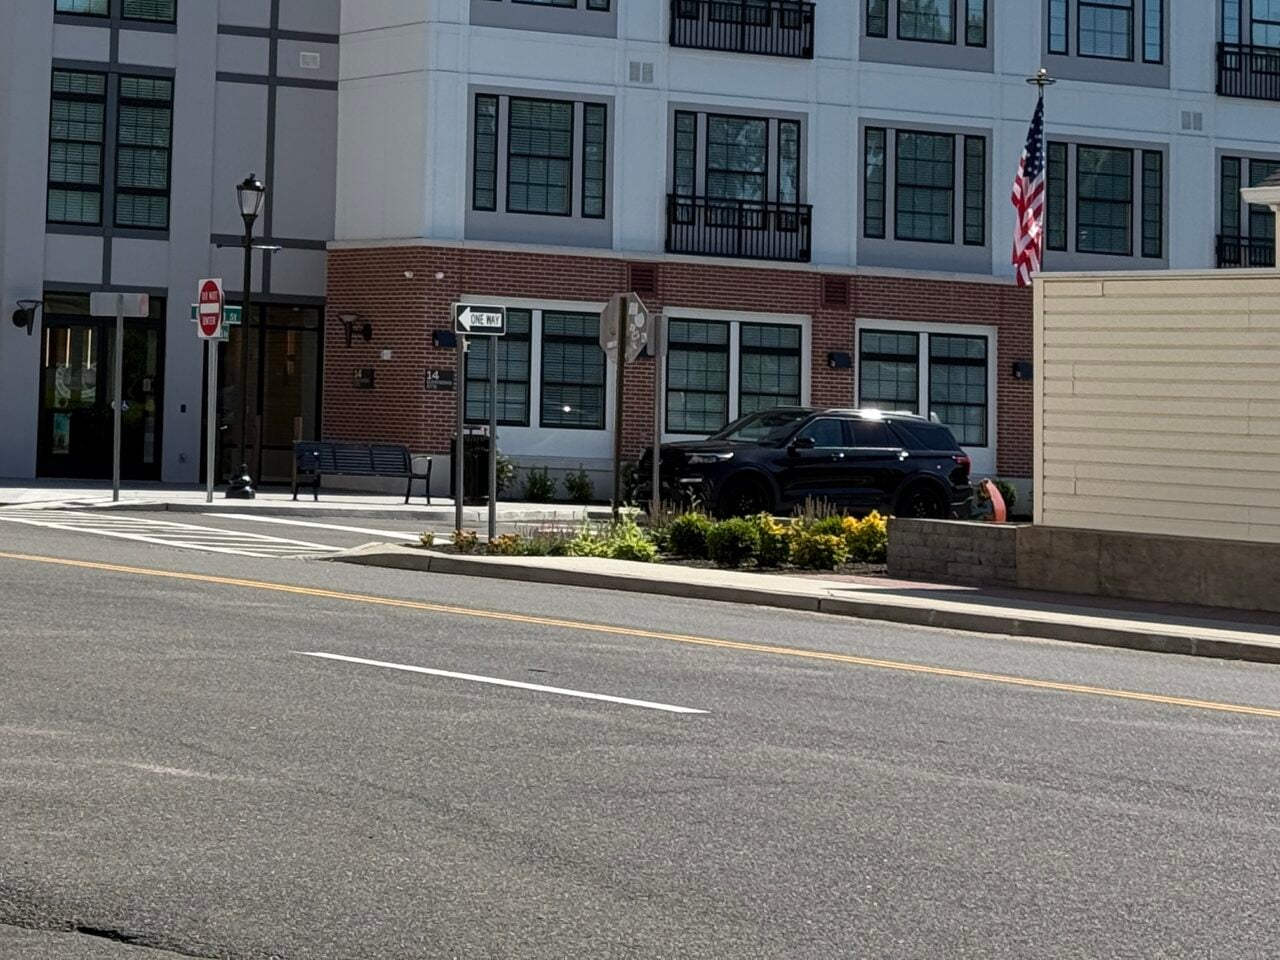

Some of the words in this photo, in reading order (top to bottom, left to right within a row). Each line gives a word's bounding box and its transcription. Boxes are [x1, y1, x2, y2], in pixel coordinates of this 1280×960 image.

[201, 290, 208, 300] DO
[209, 290, 218, 300] NOT
[202, 316, 216, 326] ENTER
[471, 313, 484, 325] ONE
[486, 314, 500, 326] WAY
[426, 370, 440, 380] 14
